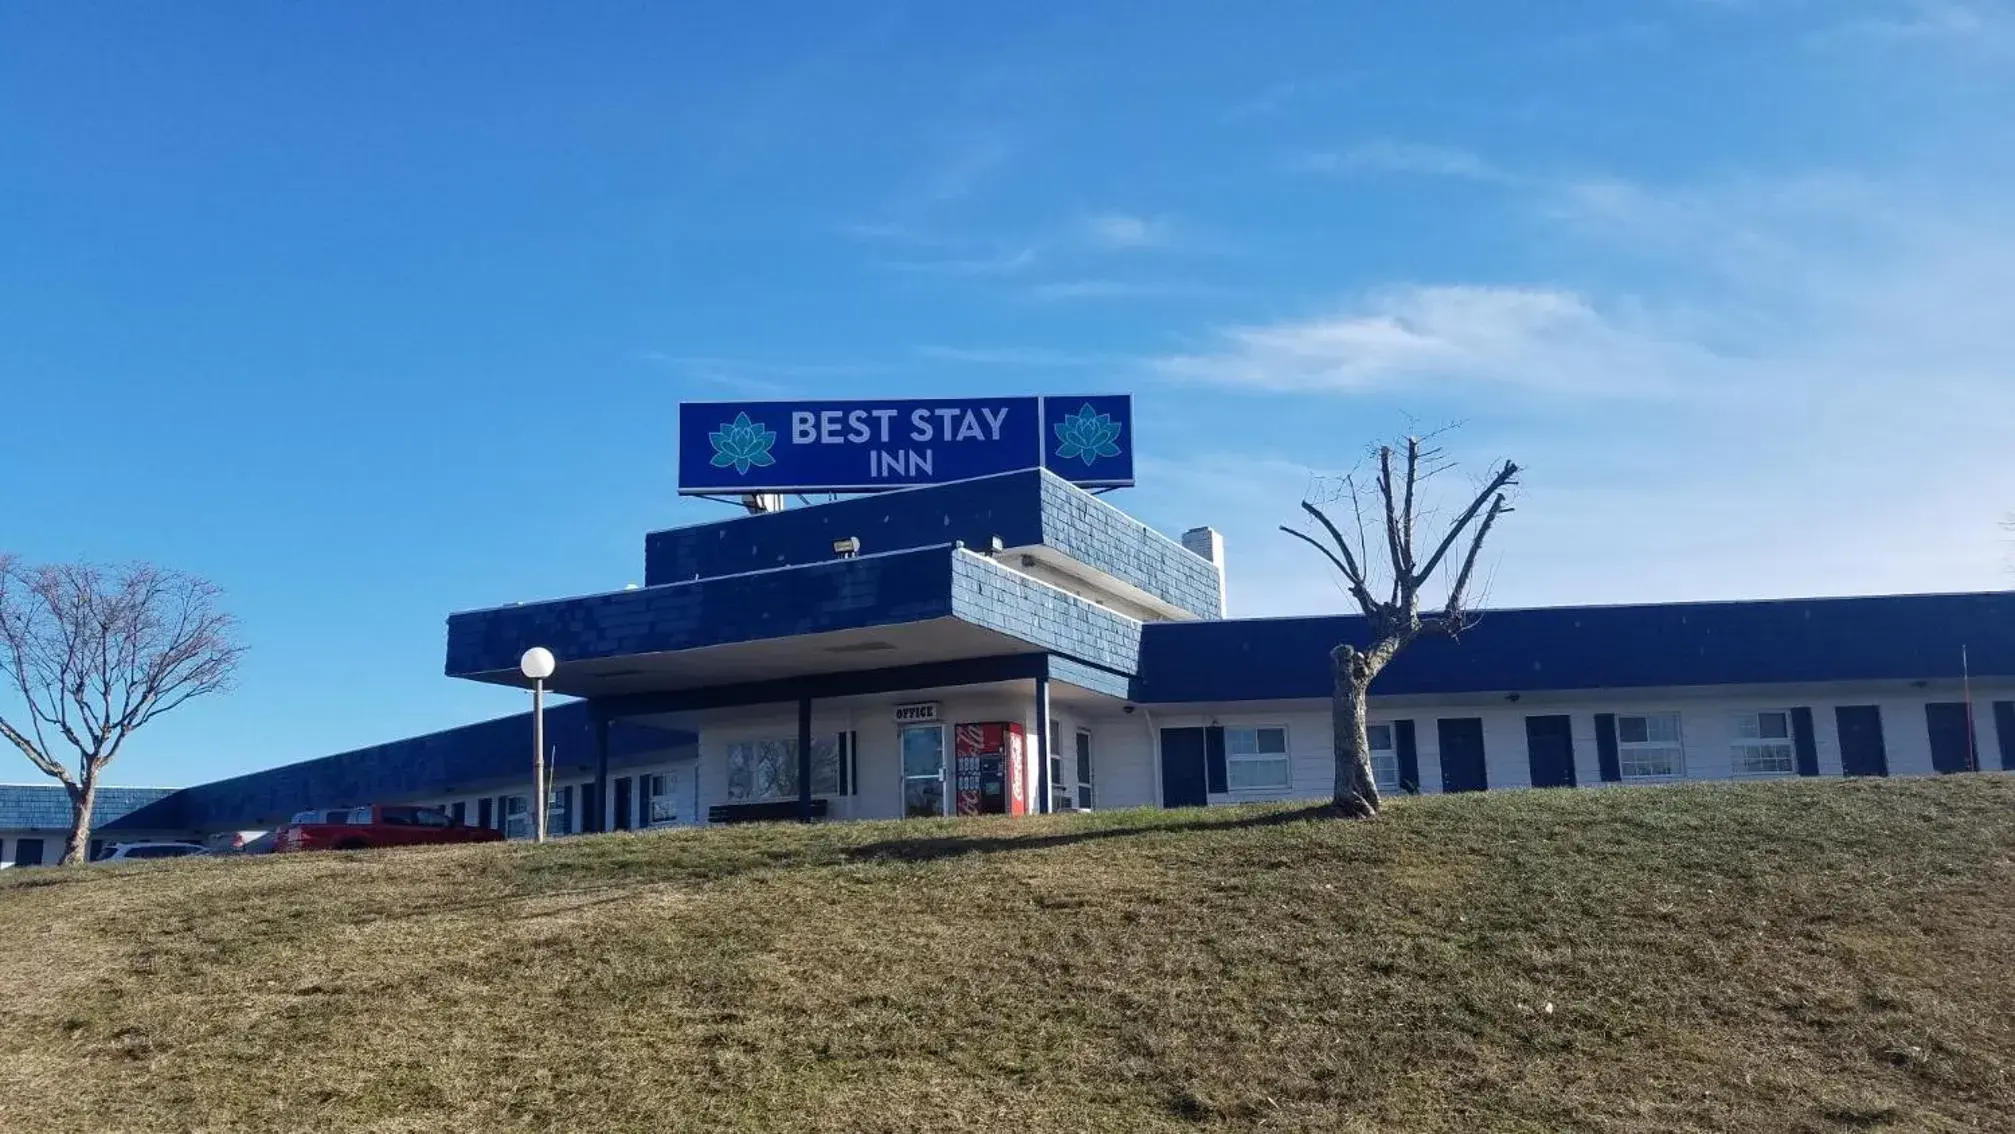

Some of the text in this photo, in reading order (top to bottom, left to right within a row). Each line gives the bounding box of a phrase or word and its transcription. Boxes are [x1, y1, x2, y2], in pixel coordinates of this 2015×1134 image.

[791, 408, 1008, 444] BEST STAY
[870, 449, 933, 477] INN
[897, 706, 934, 720] OFFICE
